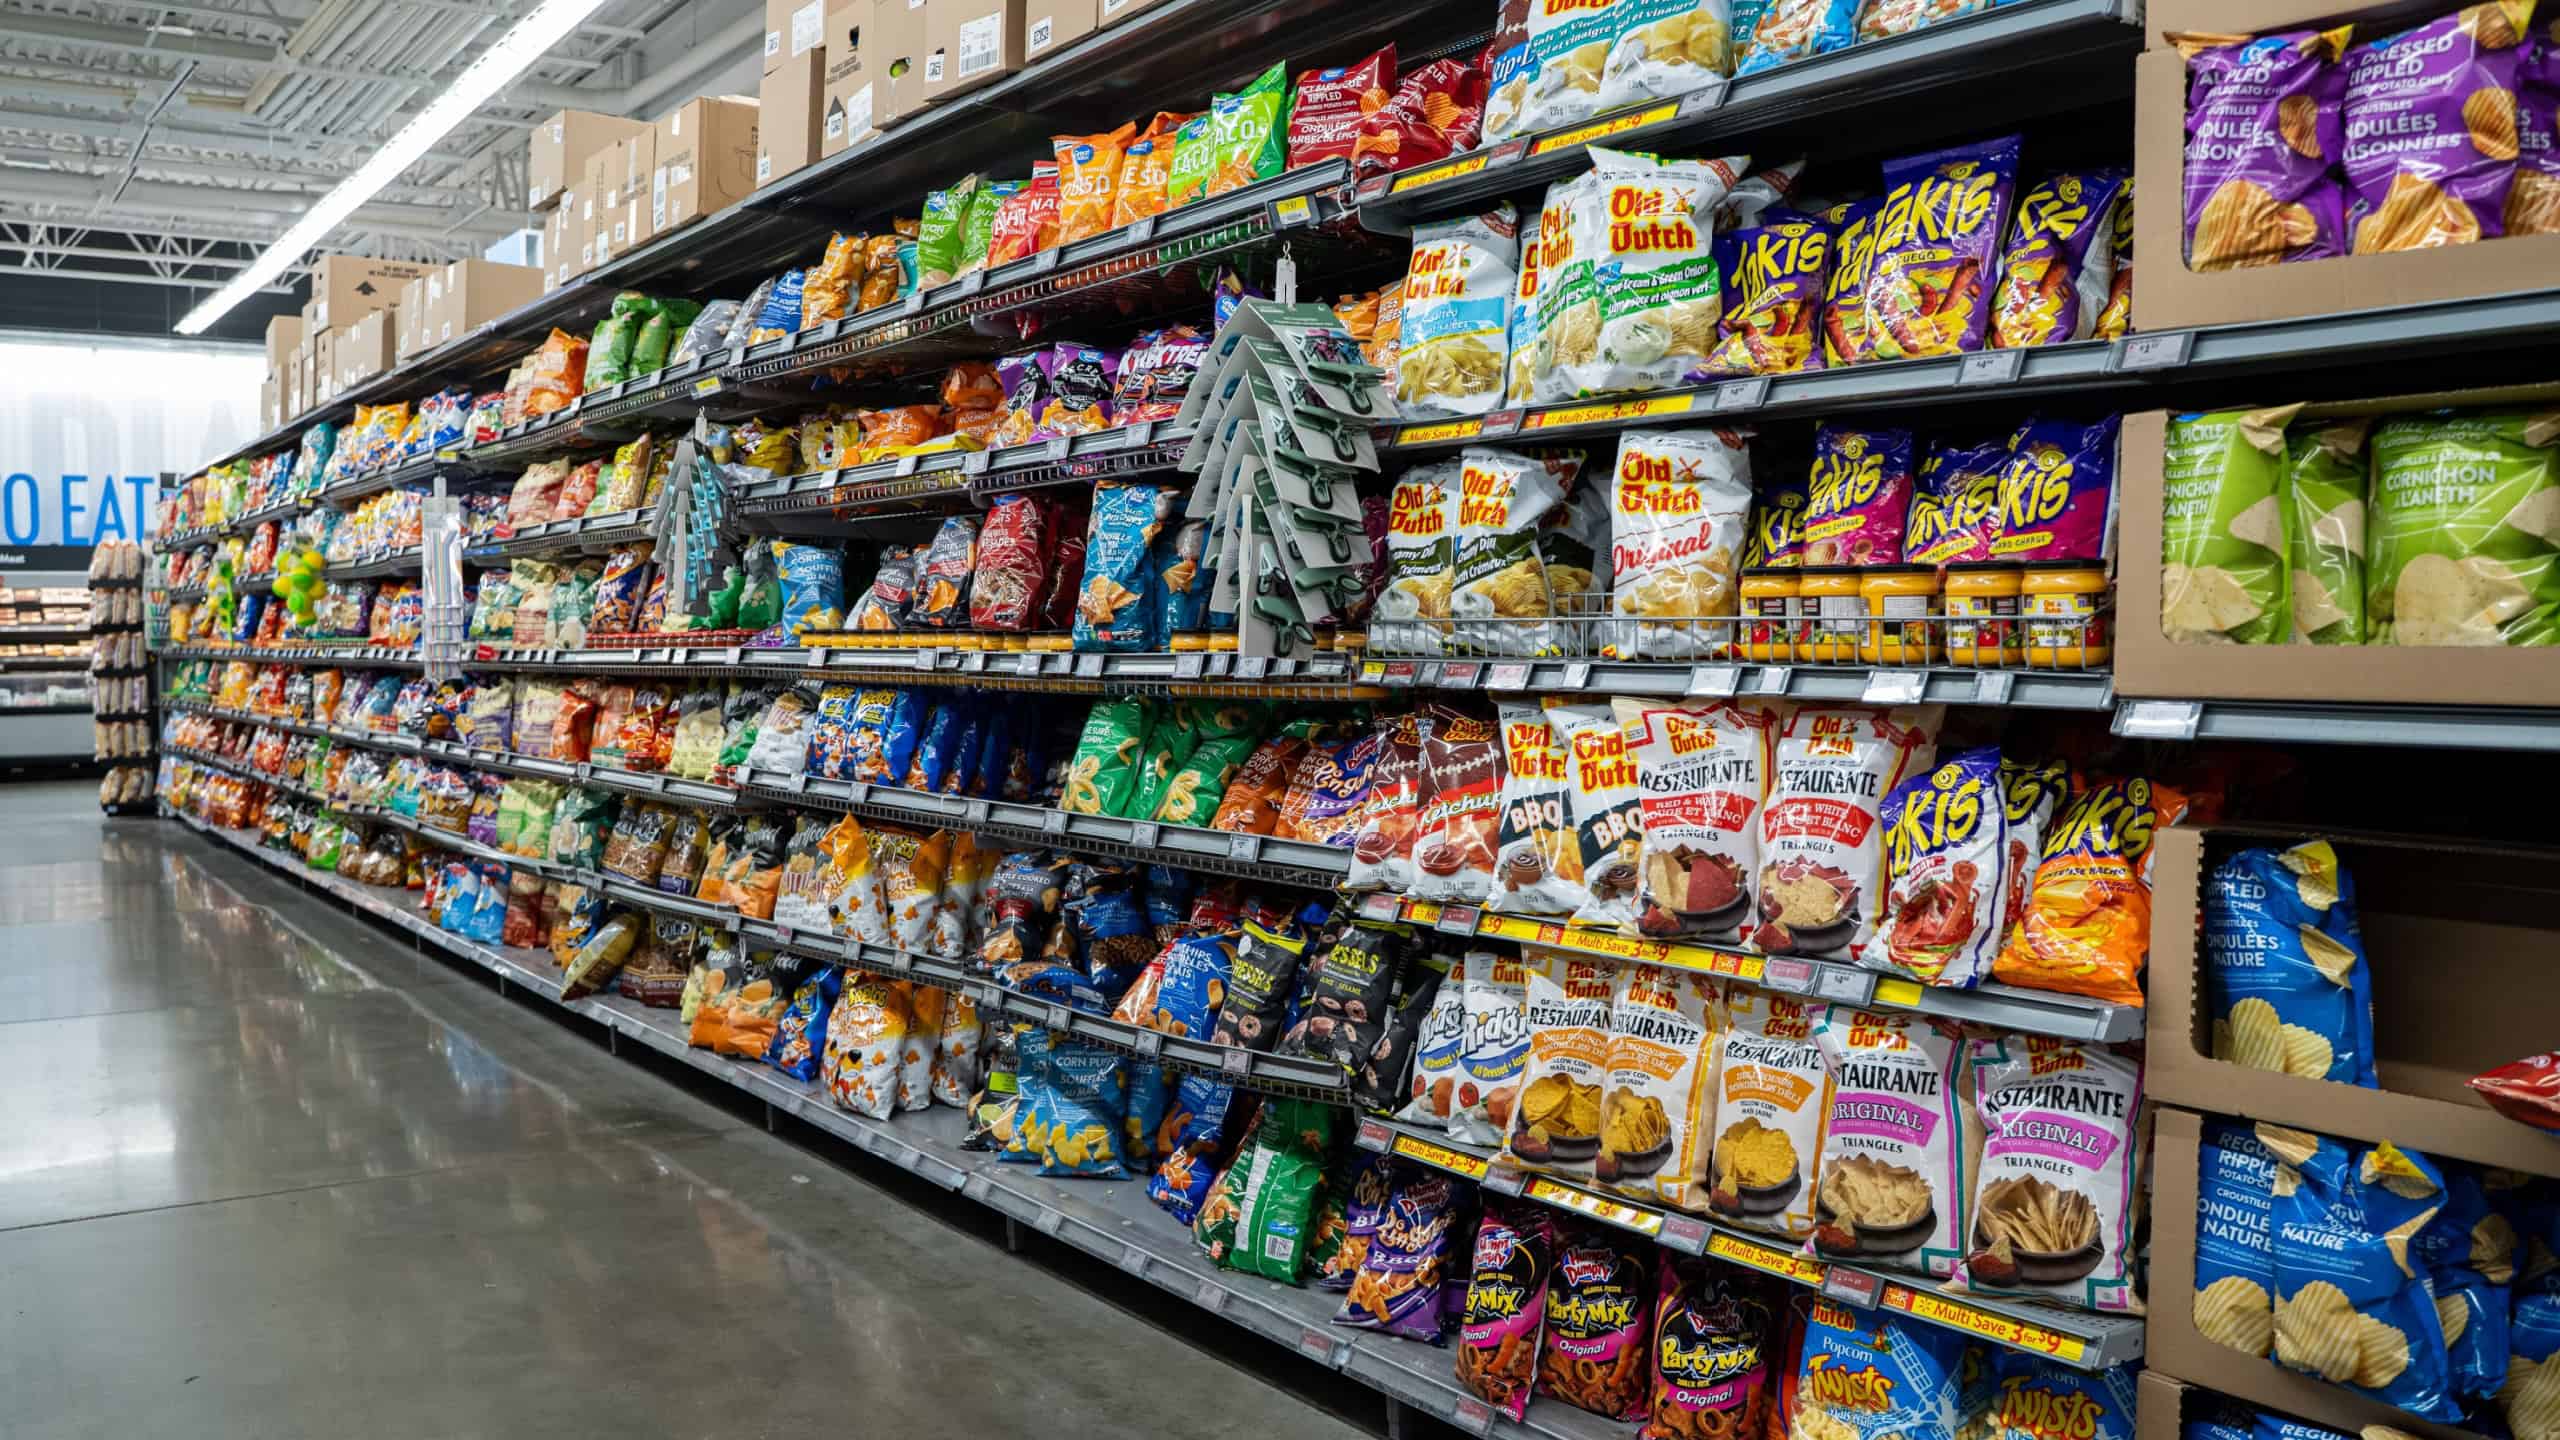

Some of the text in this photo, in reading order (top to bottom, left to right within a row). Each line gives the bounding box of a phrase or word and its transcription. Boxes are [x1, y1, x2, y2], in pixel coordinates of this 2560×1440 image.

[2360, 35, 2454, 66] DRESSED
[1307, 92, 1343, 106] RIPPLED
[1610, 186, 1664, 218] Old
[1610, 221, 1695, 253] Dutch
[1683, 262, 1709, 281] Onion
[1556, 413, 1582, 426] Multi
[1584, 409, 1608, 422] Save
[1611, 405, 1620, 420] 3
[1622, 451, 1673, 483] Old
[2386, 465, 2497, 492] CORNICHON
[1463, 468, 1492, 497] Old
[61, 473, 155, 547] EAT
[1394, 486, 1425, 511] Old
[1621, 484, 1700, 513] Dutch
[1389, 511, 1444, 534] Dutch
[1459, 498, 1508, 528] Dutch
[1612, 521, 1714, 577] Original
[1508, 724, 1551, 750] Old
[1812, 715, 1841, 734] Old
[1574, 731, 1624, 758] Old
[1670, 731, 1717, 756] Dutch
[1640, 758, 1754, 793] RESTAURANTE
[1421, 791, 1502, 825] Ketchup
[1509, 799, 1562, 835] BBQ
[1685, 806, 1701, 817] ET
[1593, 807, 1643, 850] BBQ
[1660, 827, 1719, 843] TRIANGLES
[1487, 916, 1504, 934] $9
[1576, 935, 1670, 962] Multi Save 3 $9
[2213, 951, 2266, 967] NATURE
[1567, 961, 1596, 979] Old
[1564, 980, 1611, 1000] Dutch
[1628, 982, 1678, 1012] Dutch
[1769, 995, 1801, 1018] Old
[1853, 1011, 1887, 1027] Old
[1849, 1028, 1908, 1051] Dutch
[1055, 1055, 1087, 1068] CORN
[1726, 1040, 1821, 1072] RESTAURANTE
[2030, 1051, 2085, 1077] Dutch
[1830, 1101, 1924, 1133] ORIGINAL
[1402, 1138, 1424, 1157] Multi
[1425, 1149, 1446, 1163] Save
[1446, 1151, 1457, 1168] 3
[1841, 1135, 1904, 1155] TRIANGLES
[2003, 1155, 2075, 1177] TRIANGLES
[2218, 1167, 2256, 1185] POTATO
[2197, 1197, 2272, 1233] ONDULÉ
[2203, 1220, 2272, 1252] NATURE
[2280, 1226, 2348, 1251] NATURE
[1722, 1239, 1755, 1259] Multi
[1756, 1249, 1785, 1270] Save
[1784, 1258, 1798, 1277] 3
[1478, 1284, 1522, 1317] Mix
[1587, 1298, 1633, 1330] Mix
[1933, 1302, 2062, 1353] Multi Save 3 for $9
[1559, 1339, 1607, 1355] Original
[1661, 1336, 1760, 1377] Party Mix
[1822, 1336, 1874, 1363] Popcorn
[1676, 1382, 1734, 1407] Original
[1807, 1355, 1895, 1408] Twists
[2000, 1375, 2104, 1439] Twists
